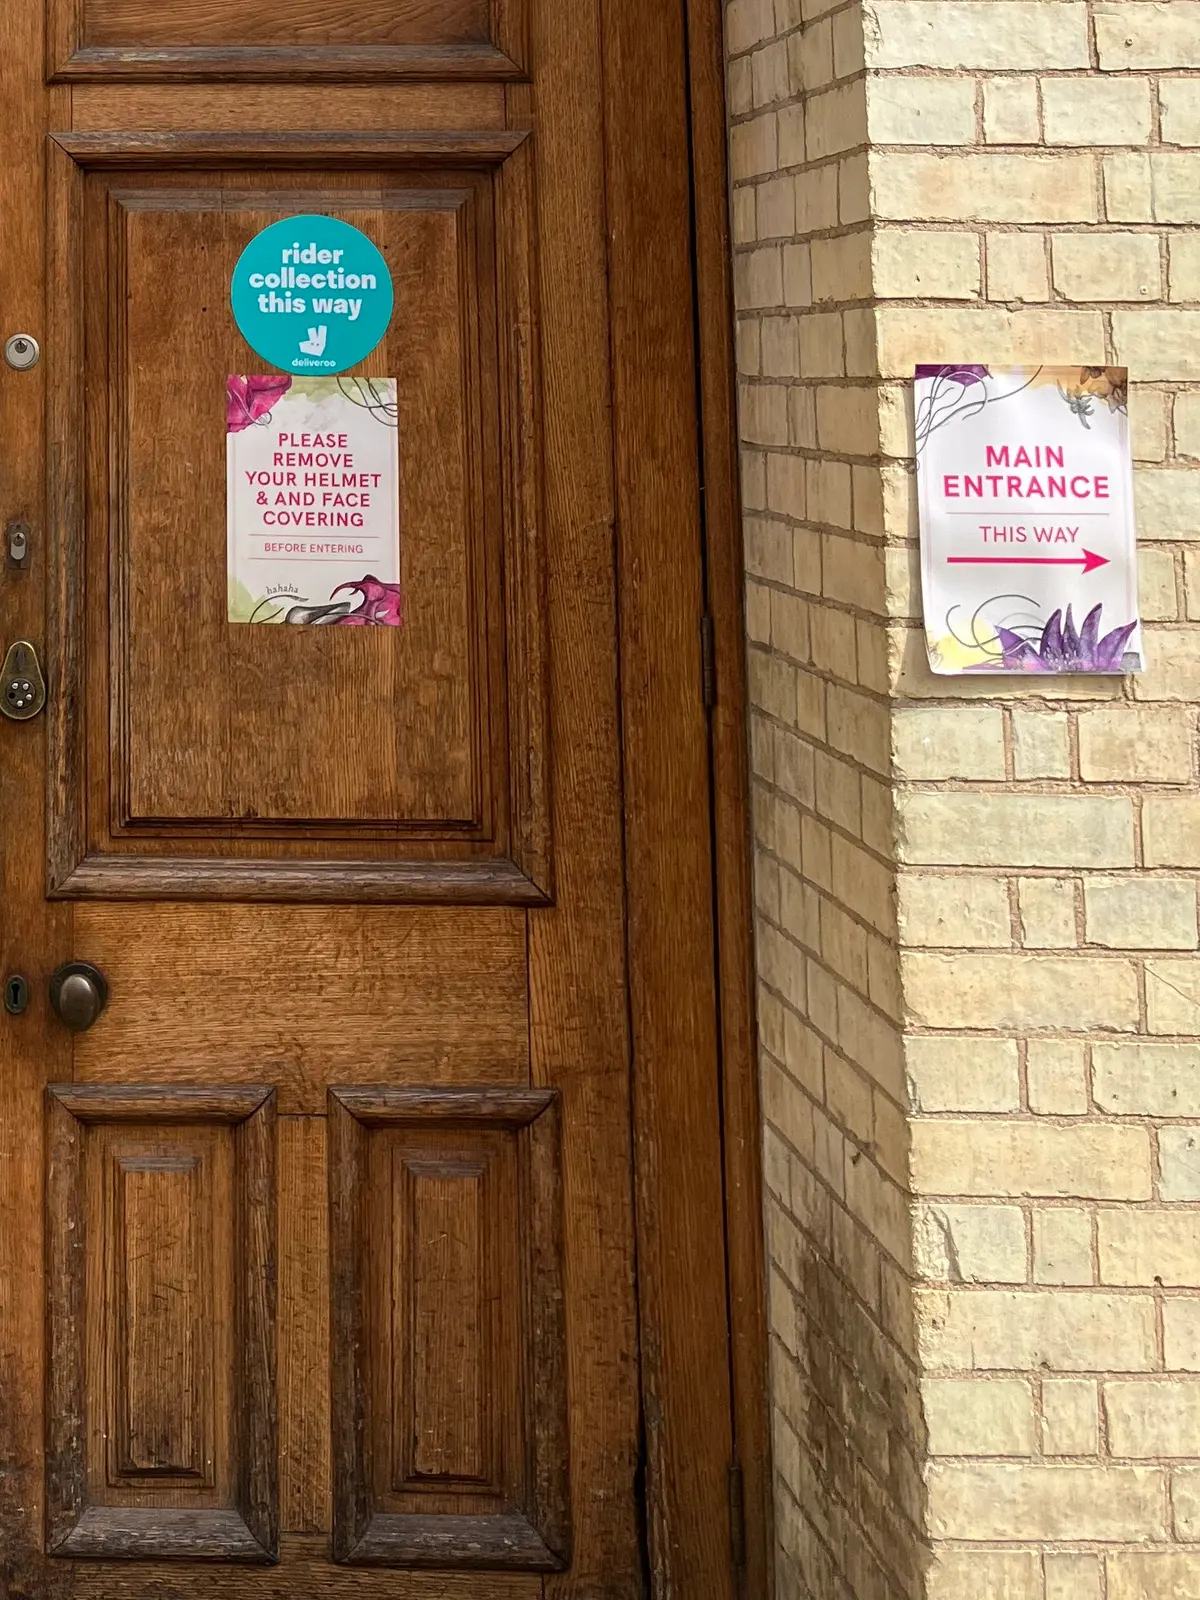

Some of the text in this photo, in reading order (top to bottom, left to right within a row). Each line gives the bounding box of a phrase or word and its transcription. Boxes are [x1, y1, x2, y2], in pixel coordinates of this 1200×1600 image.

[282, 242, 344, 264] rider
[249, 267, 377, 289] collection
[258, 291, 362, 321] this way
[291, 357, 336, 368] deliveroo
[278, 432, 348, 449] PLEASE
[273, 452, 353, 468] REMOVE
[986, 445, 1065, 468] MAIN
[245, 471, 382, 489] YOUR HELMET
[943, 475, 1110, 498] ENTRANCE
[256, 491, 371, 508] & AND FACE
[262, 510, 365, 528] COVERING
[978, 526, 1080, 544] THIS WAY
[264, 542, 364, 554] BEFORE ENTERING
